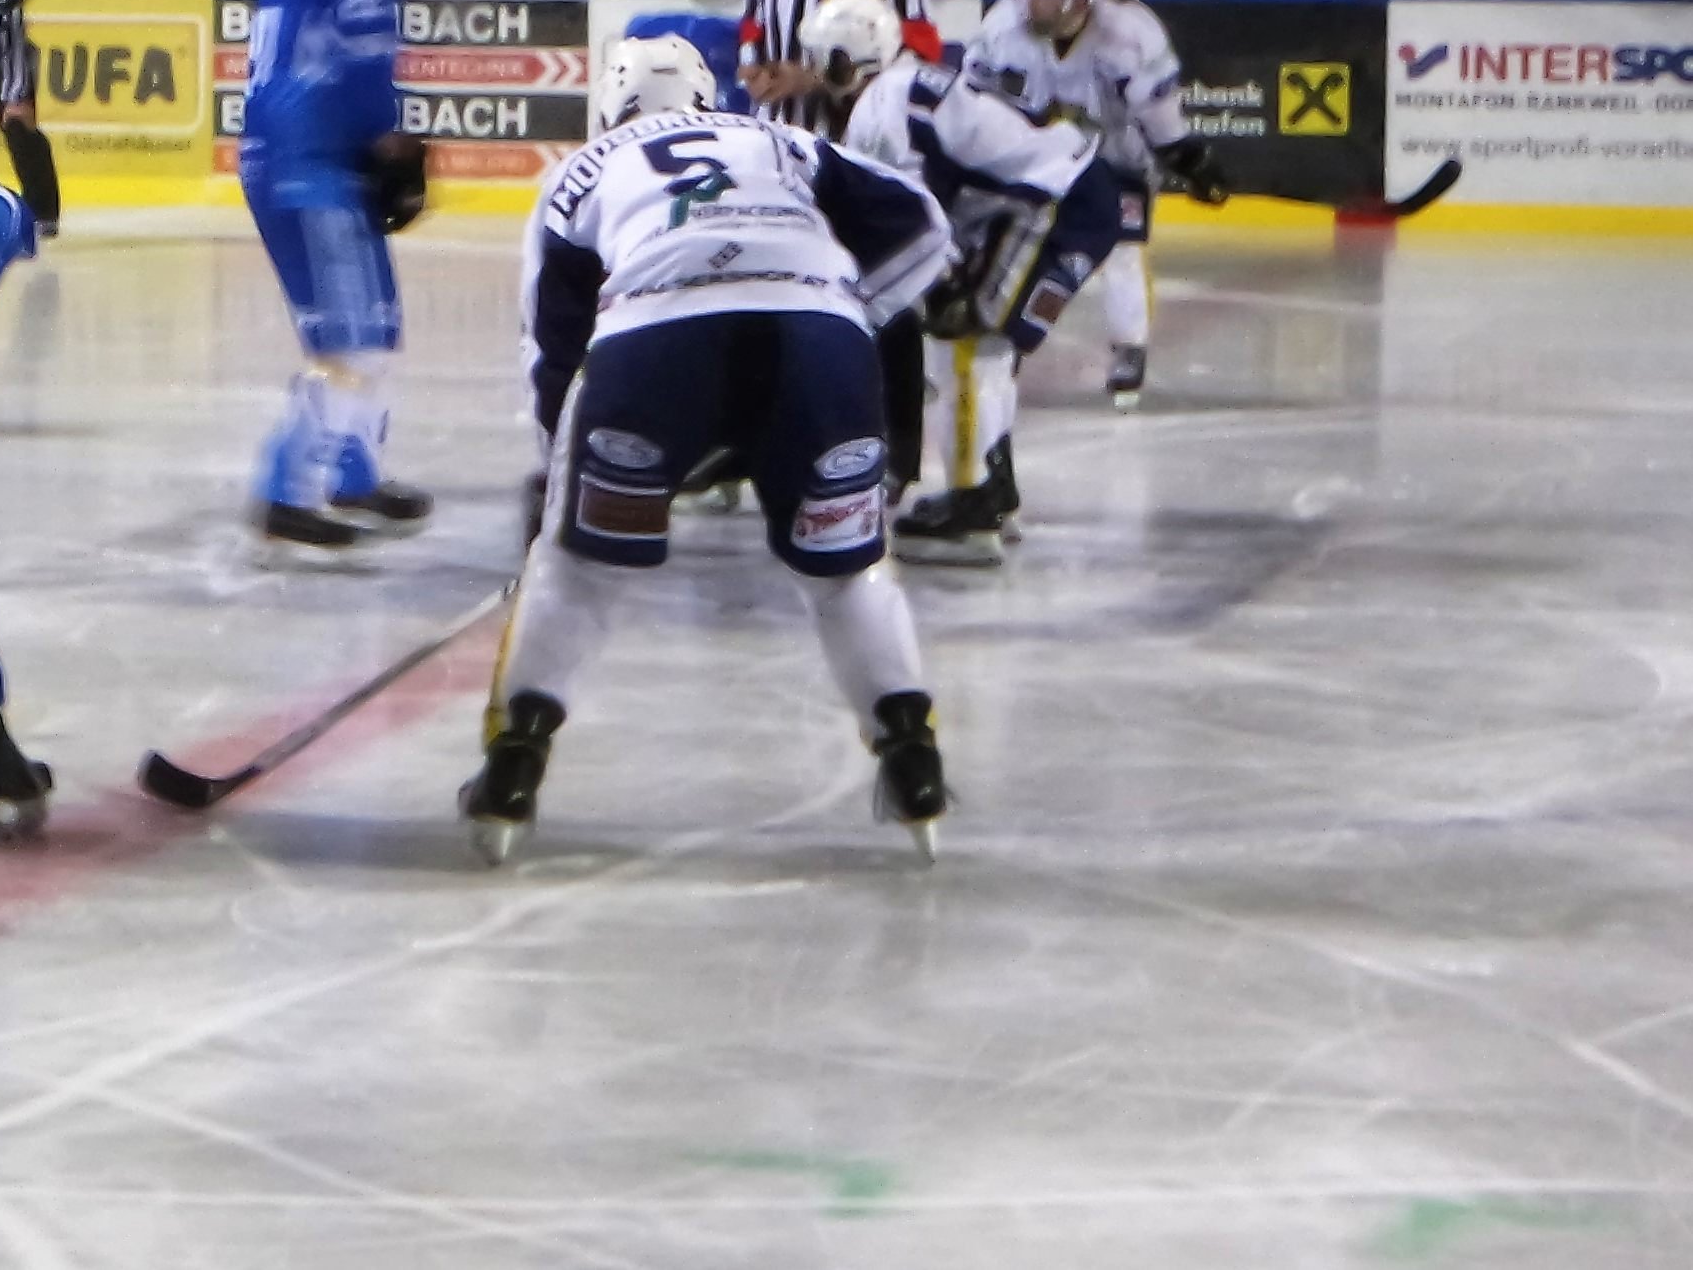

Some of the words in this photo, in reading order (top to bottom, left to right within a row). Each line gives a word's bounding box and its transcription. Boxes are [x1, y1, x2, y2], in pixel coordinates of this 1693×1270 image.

[393, 2, 529, 43] BACH
[47, 43, 176, 105] UFA
[393, 96, 529, 137] BACH
[639, 129, 731, 196] 5
